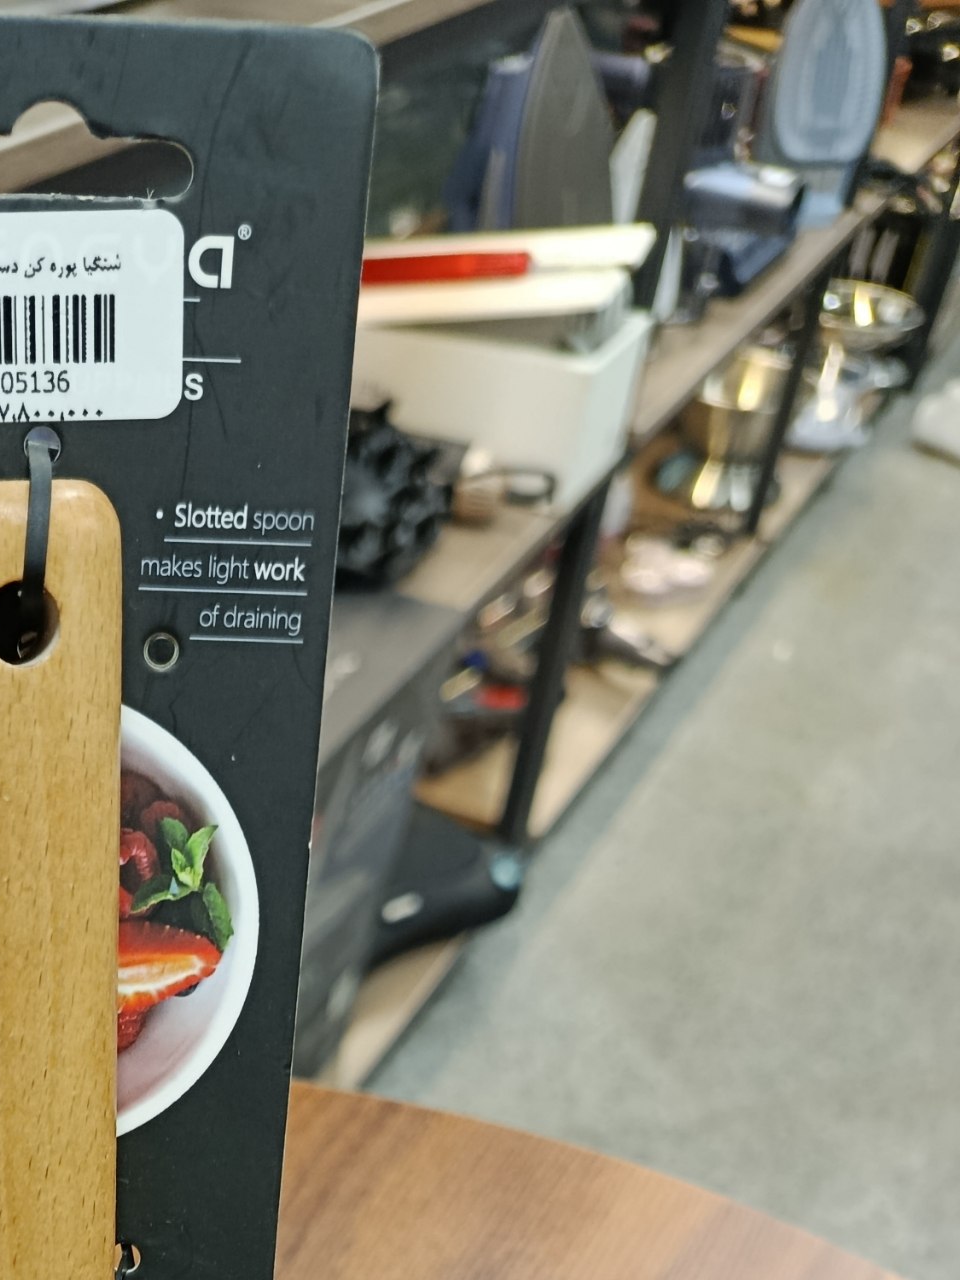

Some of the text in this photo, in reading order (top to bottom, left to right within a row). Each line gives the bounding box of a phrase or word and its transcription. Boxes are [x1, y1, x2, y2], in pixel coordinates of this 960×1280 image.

[24, 256, 46, 279] کن
[50, 261, 77, 278] پوره
[174, 501, 315, 536] Slotted spoon
[140, 553, 306, 585] makes light work
[199, 602, 301, 636] of draining
